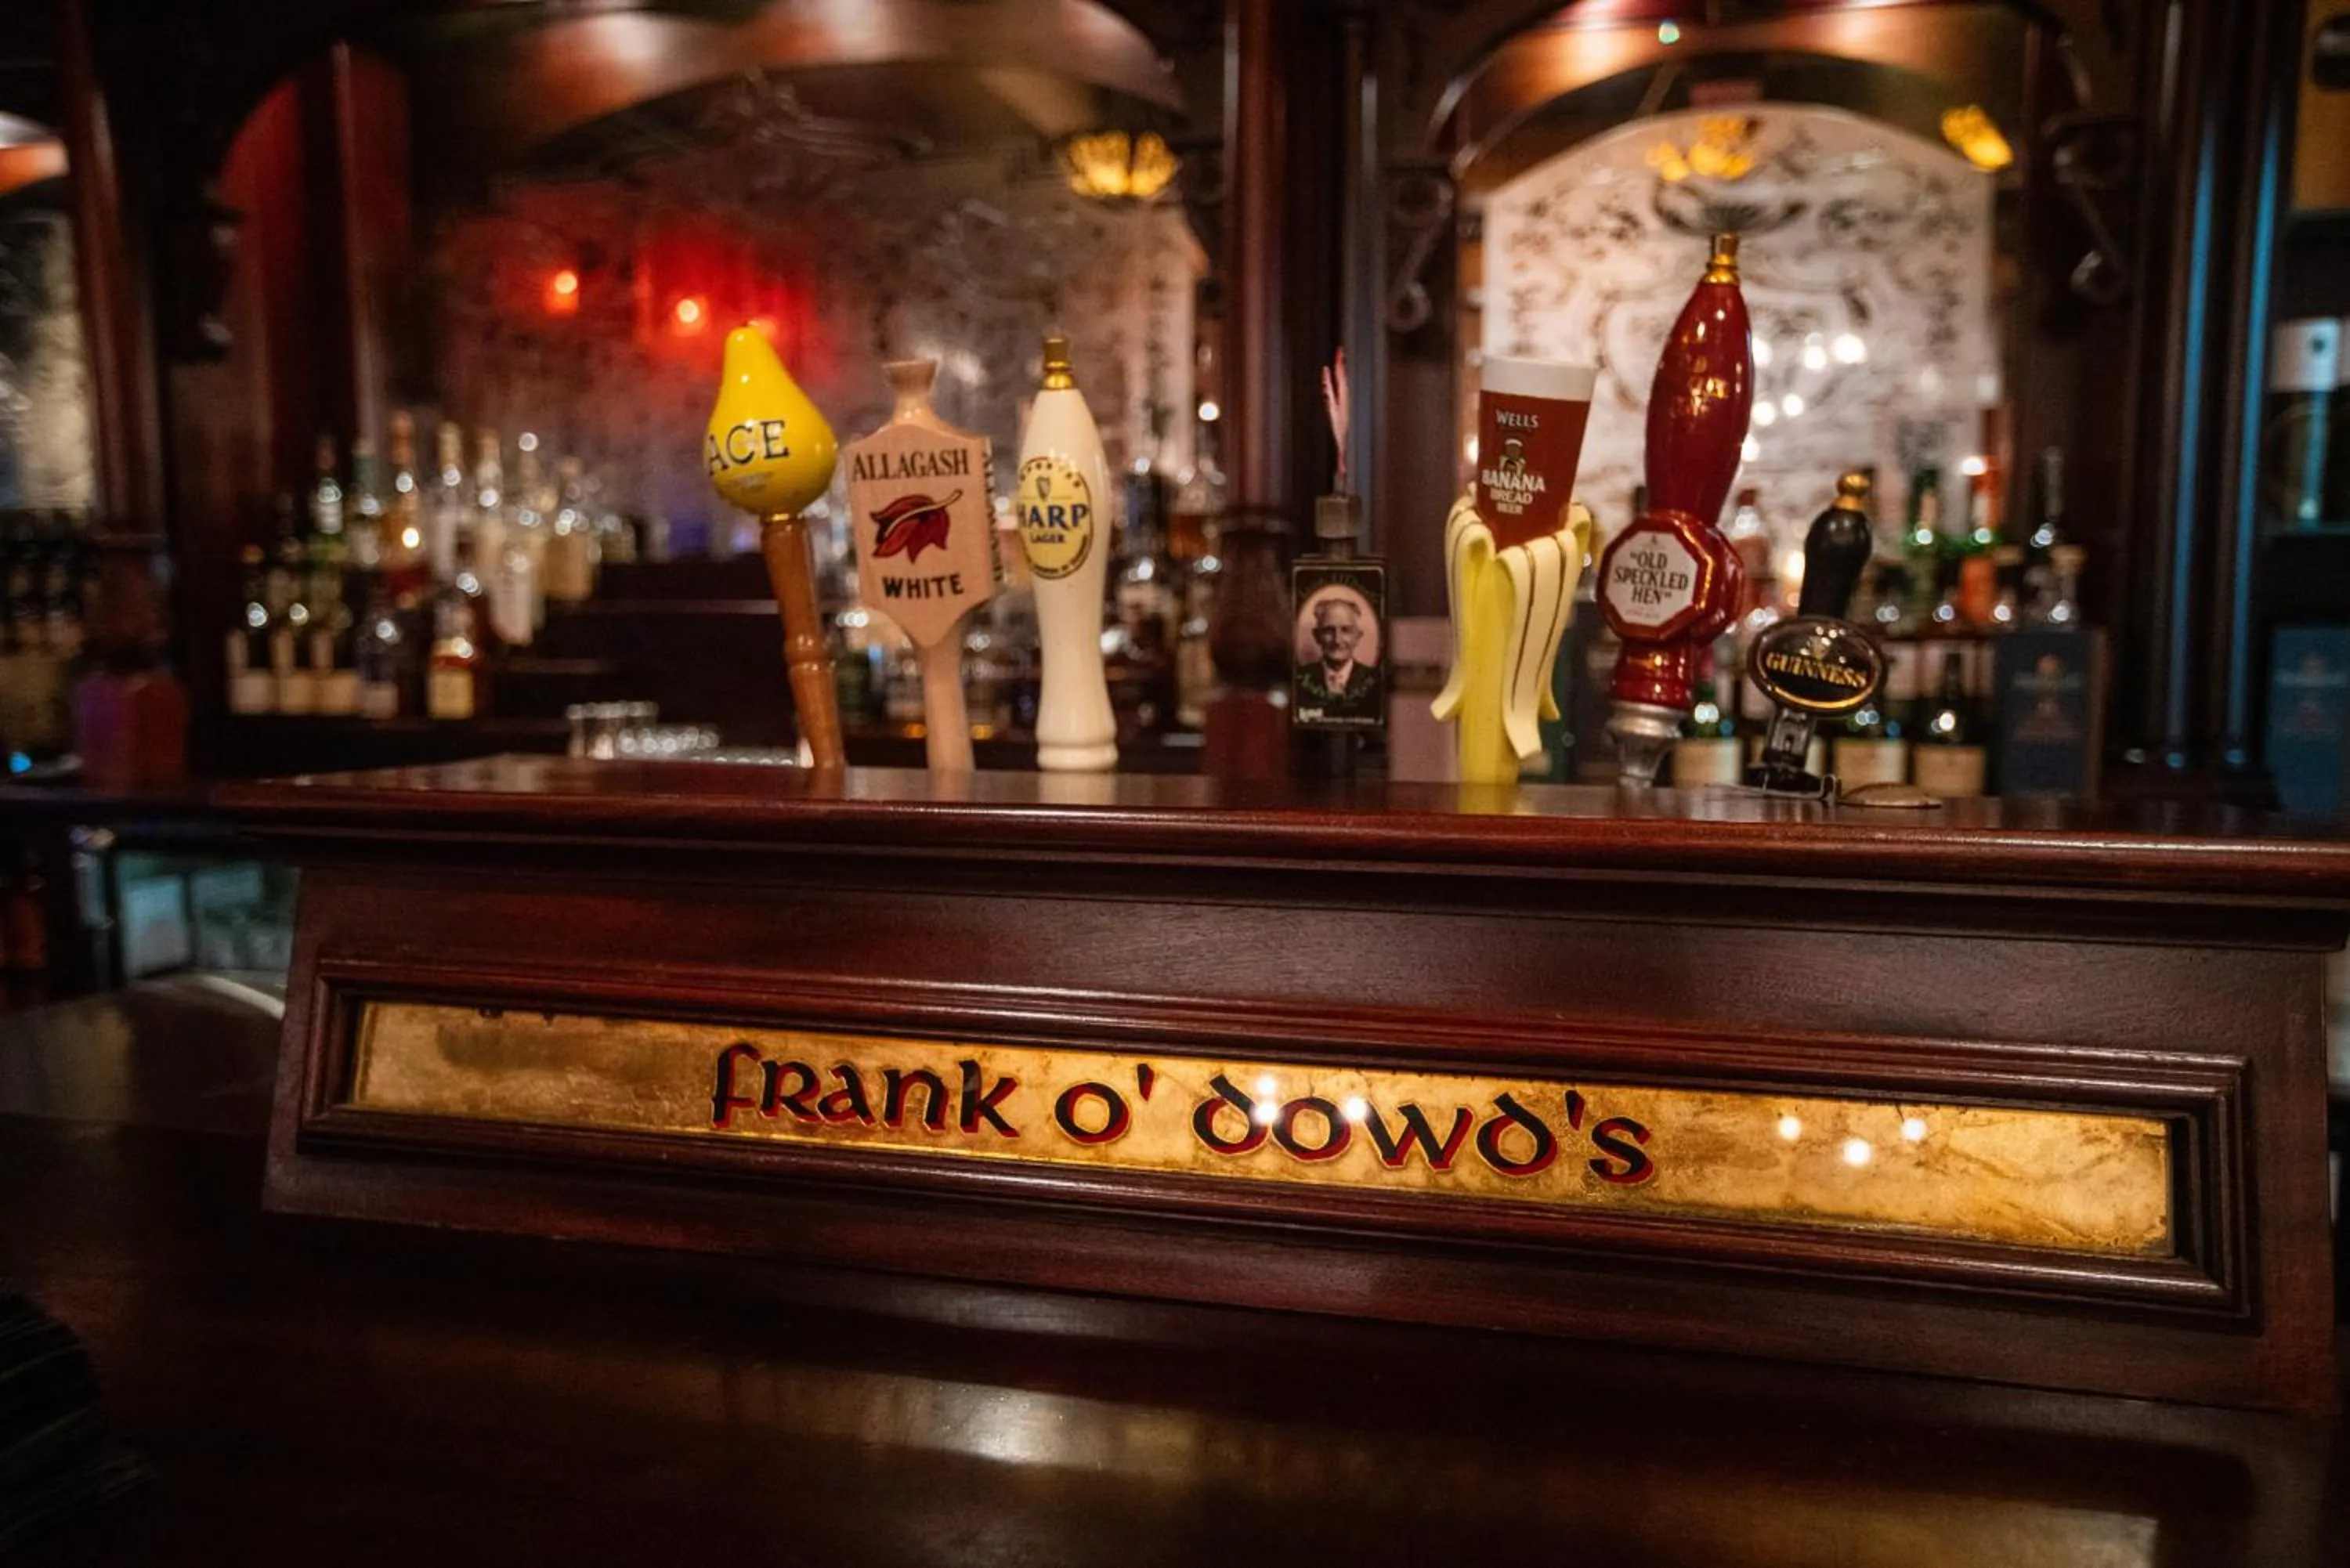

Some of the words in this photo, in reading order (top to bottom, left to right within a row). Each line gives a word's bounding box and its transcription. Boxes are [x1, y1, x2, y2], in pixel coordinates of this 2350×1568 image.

[1495, 408, 1538, 428] WELLS
[708, 420, 790, 476] ACE
[852, 449, 969, 482] ALLAGASH
[1481, 469, 1546, 492] BANANA
[1490, 487, 1533, 505] BREAD
[1030, 534, 1065, 544] LAGER
[882, 573, 964, 600] WHITE
[1614, 565, 1689, 591] SPECKLED
[1766, 652, 1867, 688] GUINNESS
